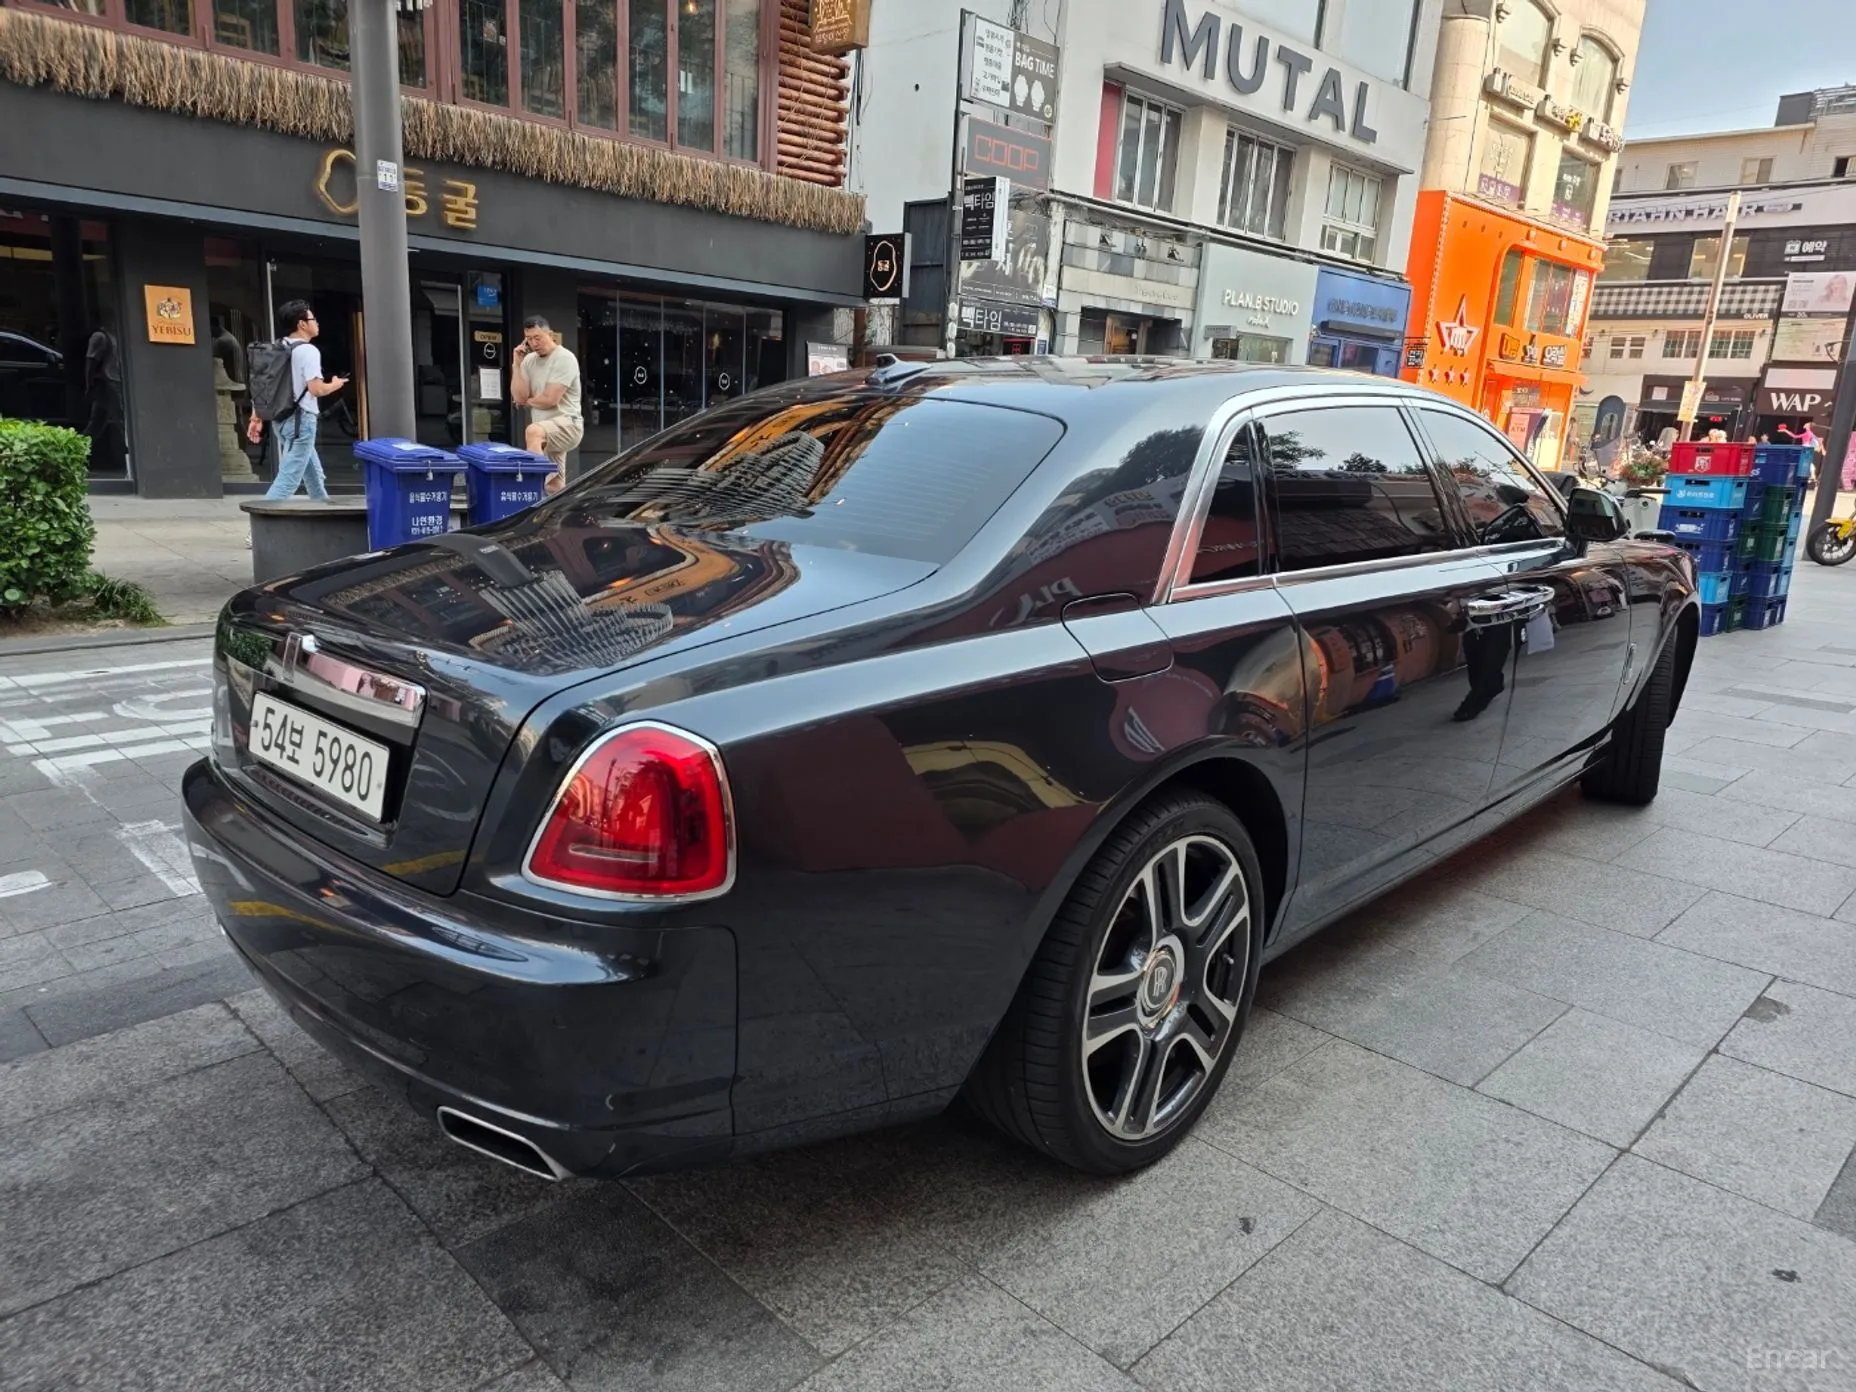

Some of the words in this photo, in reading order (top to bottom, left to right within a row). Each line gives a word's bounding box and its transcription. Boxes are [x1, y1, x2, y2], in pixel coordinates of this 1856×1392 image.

[1015, 51, 1034, 70] BAG
[1035, 57, 1056, 79] TIME
[1161, 0, 1377, 144] MUTAL
[1692, 203, 1758, 221] HAR
[1802, 240, 1828, 253] 예약
[1262, 297, 1300, 316] STUDIO
[152, 323, 192, 337] YEBISU
[1770, 392, 1822, 413] WAP
[260, 706, 304, 765] 54보
[312, 729, 373, 802] 5980
